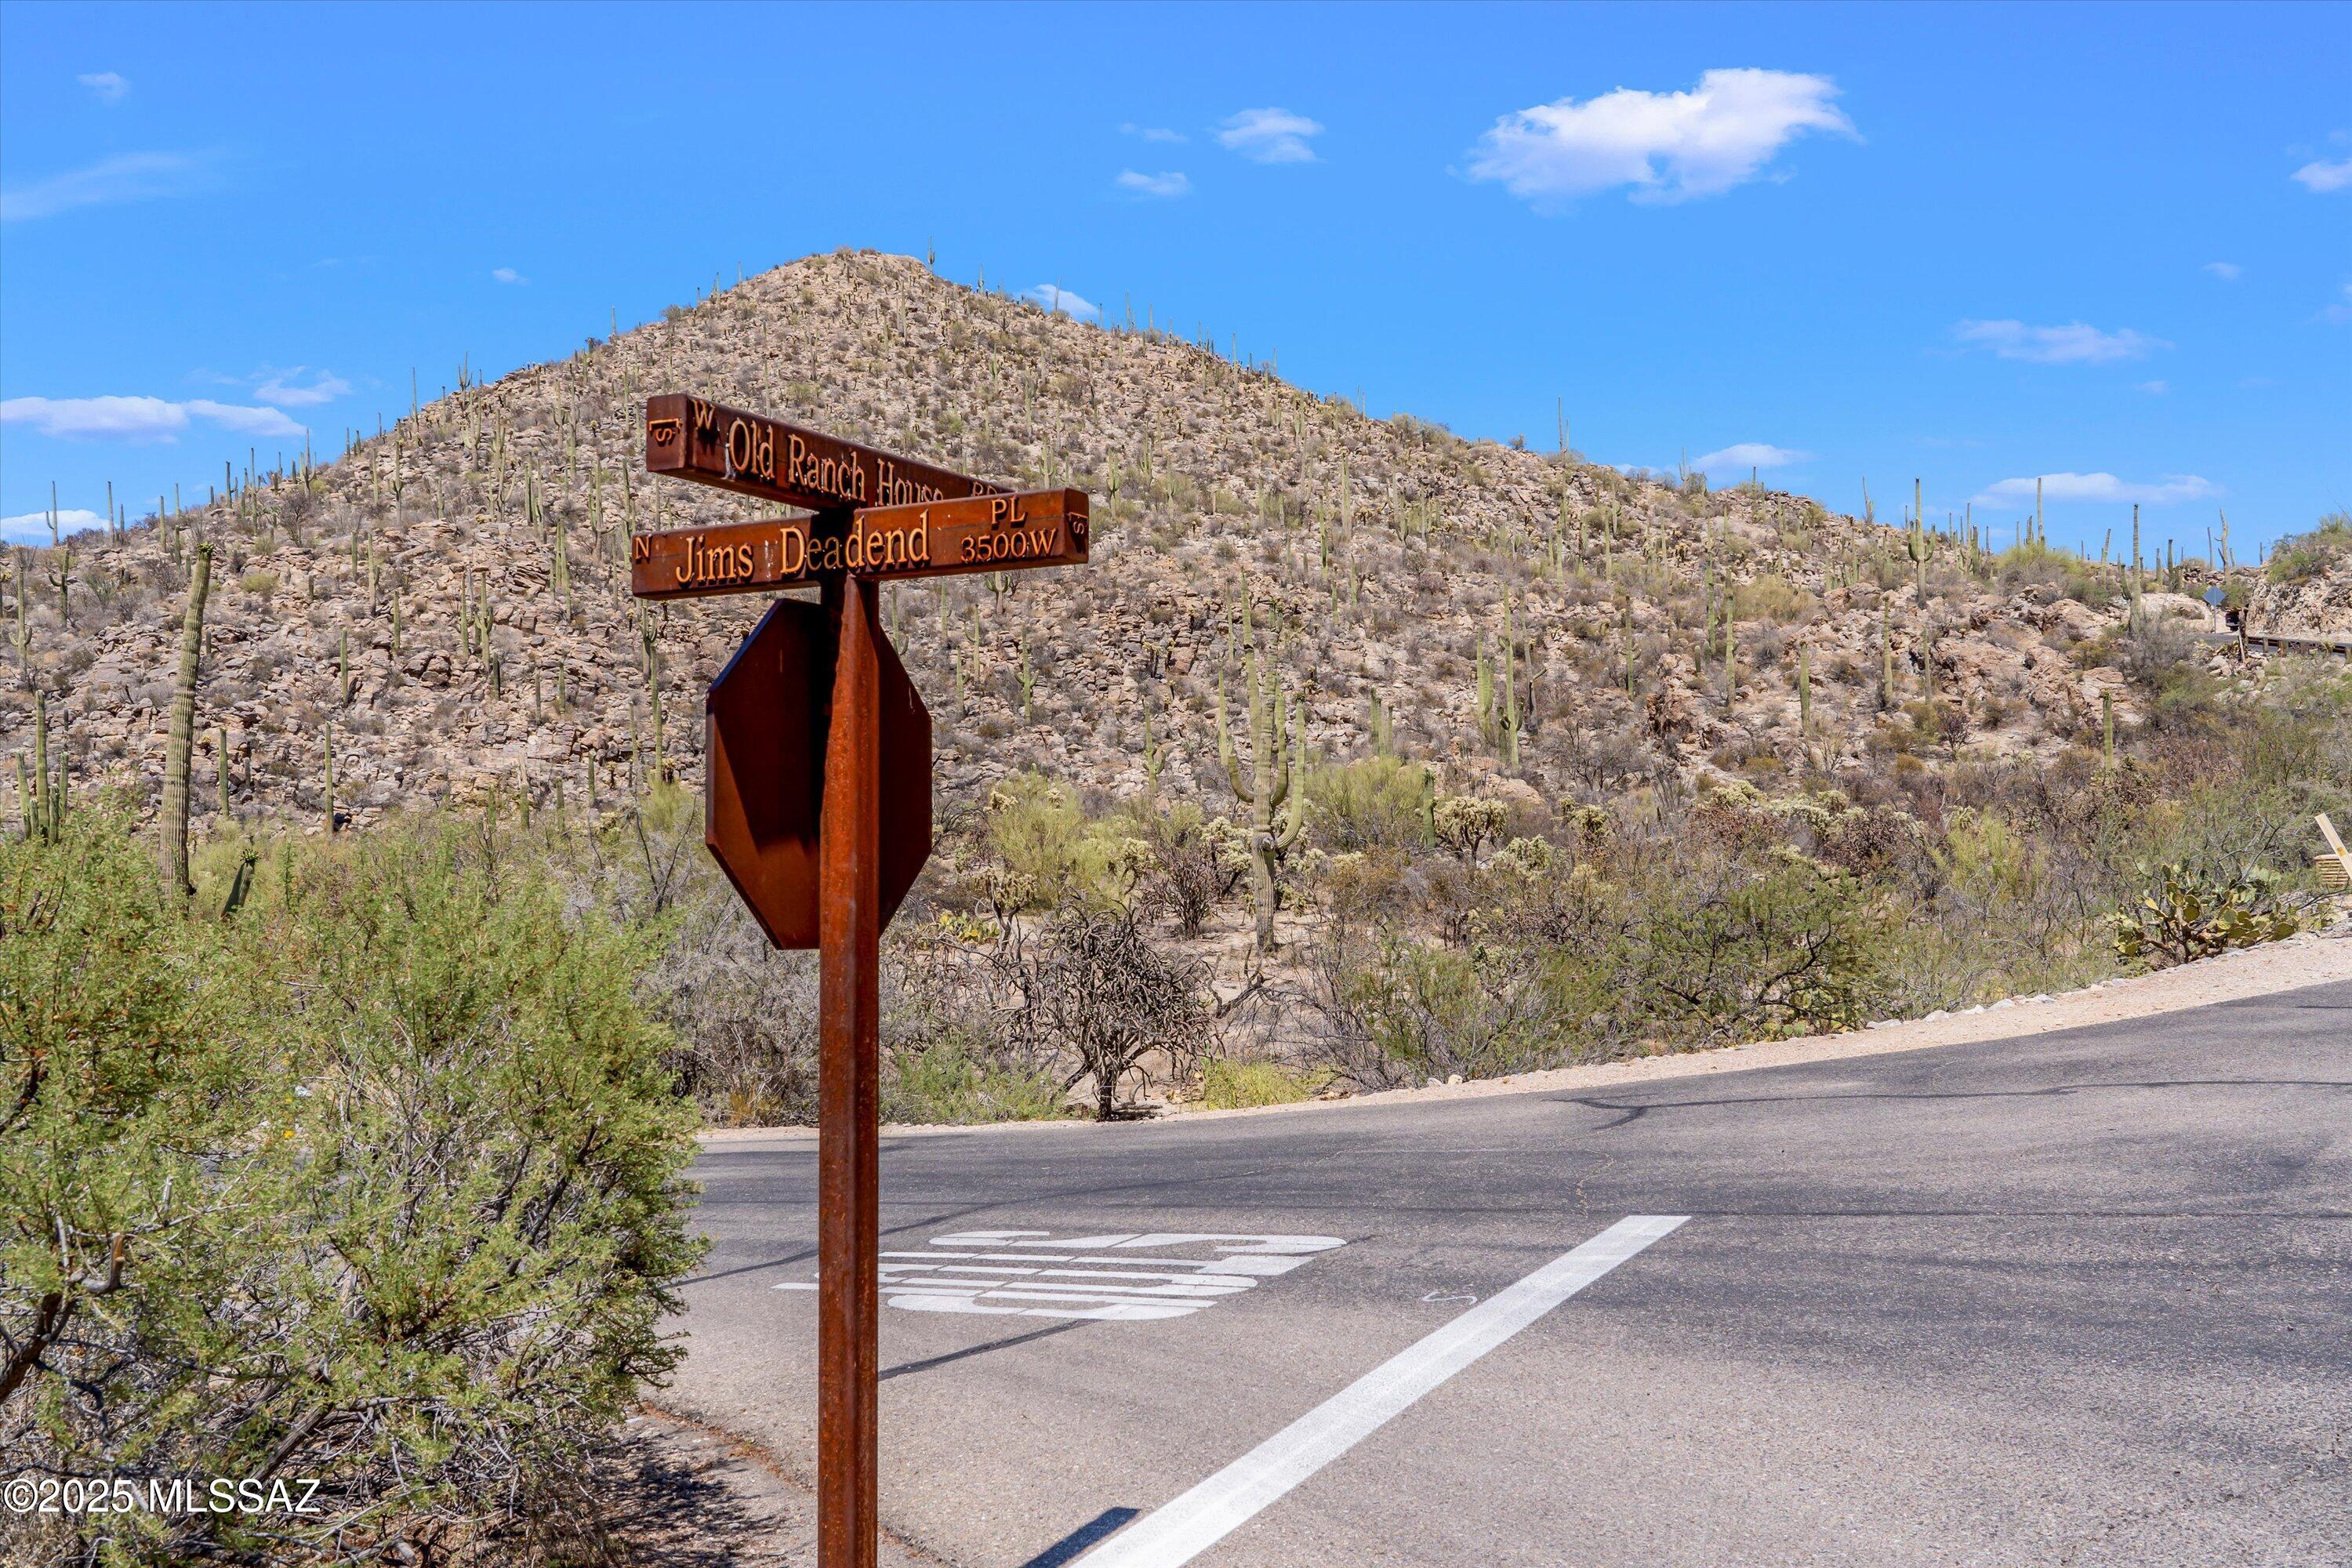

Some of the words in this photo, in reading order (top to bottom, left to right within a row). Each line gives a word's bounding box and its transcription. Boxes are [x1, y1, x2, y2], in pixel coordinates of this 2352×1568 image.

[692, 399, 715, 430] W
[728, 417, 775, 479] Old
[789, 434, 867, 502] Ranch
[635, 534, 652, 560] N
[676, 534, 754, 583] Jims
[780, 509, 929, 574] Deadend
[991, 495, 1025, 524] PL
[960, 528, 1057, 563] 3500W
[771, 1230, 1348, 1320] STOP
